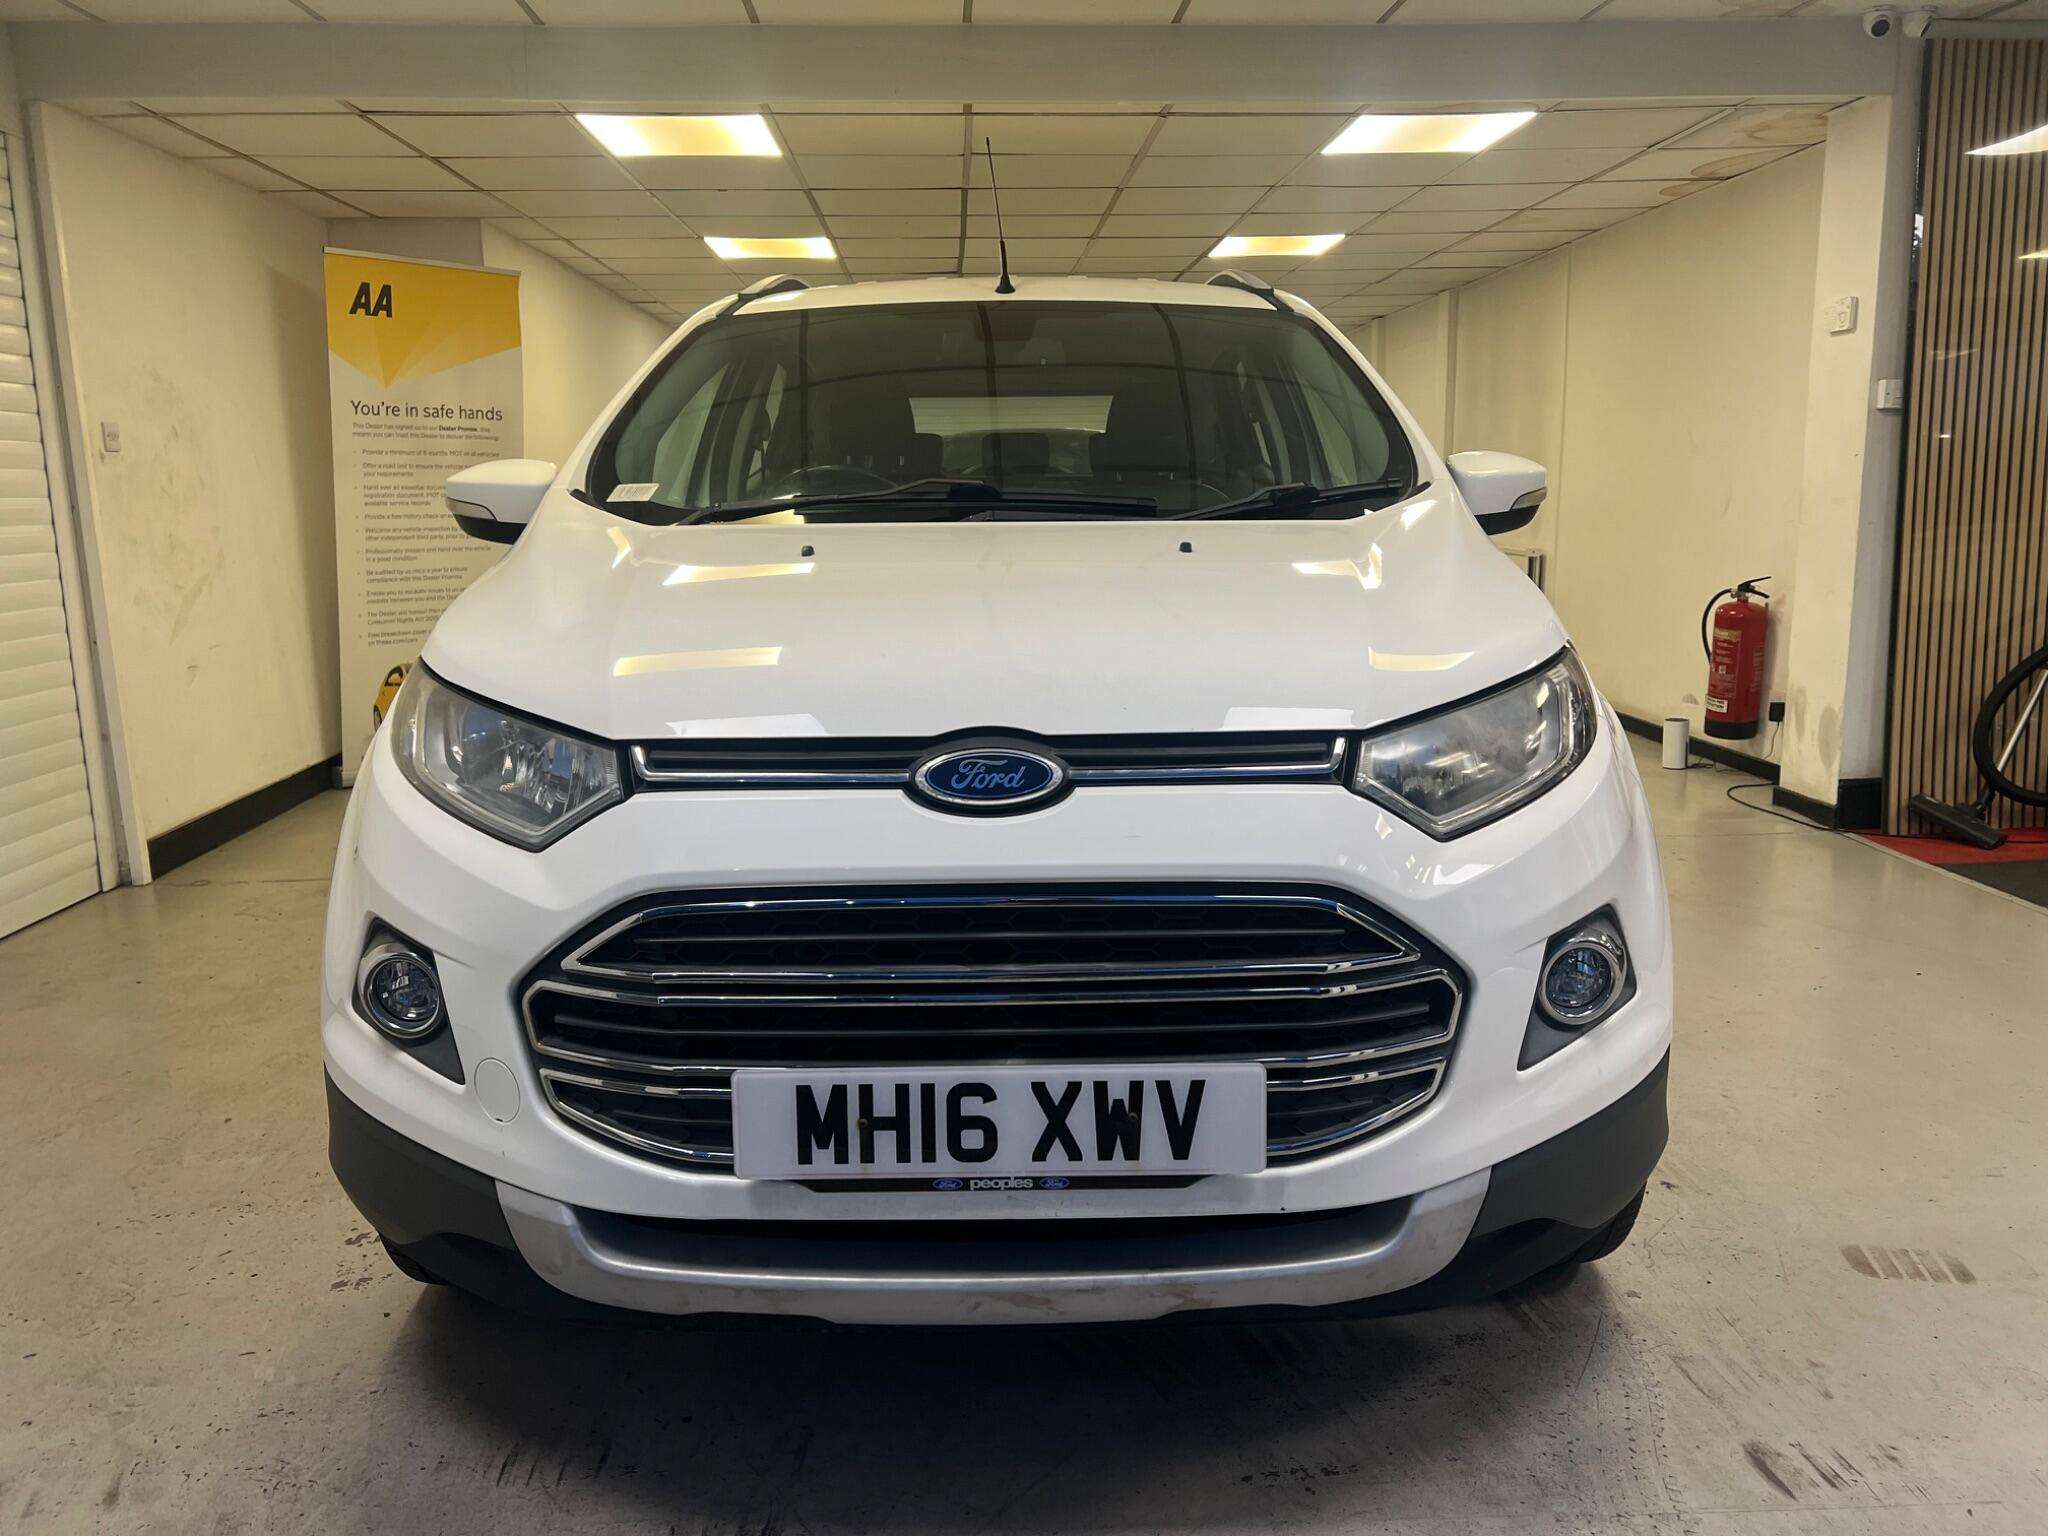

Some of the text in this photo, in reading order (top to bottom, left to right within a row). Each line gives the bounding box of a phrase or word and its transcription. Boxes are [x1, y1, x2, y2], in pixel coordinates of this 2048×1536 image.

[349, 282, 392, 318] AA
[350, 400, 503, 421] You’re in safe hands
[950, 758, 1026, 789] Ford
[796, 1079, 1206, 1165] MH16 XWV
[970, 1176, 1034, 1190] peoples
